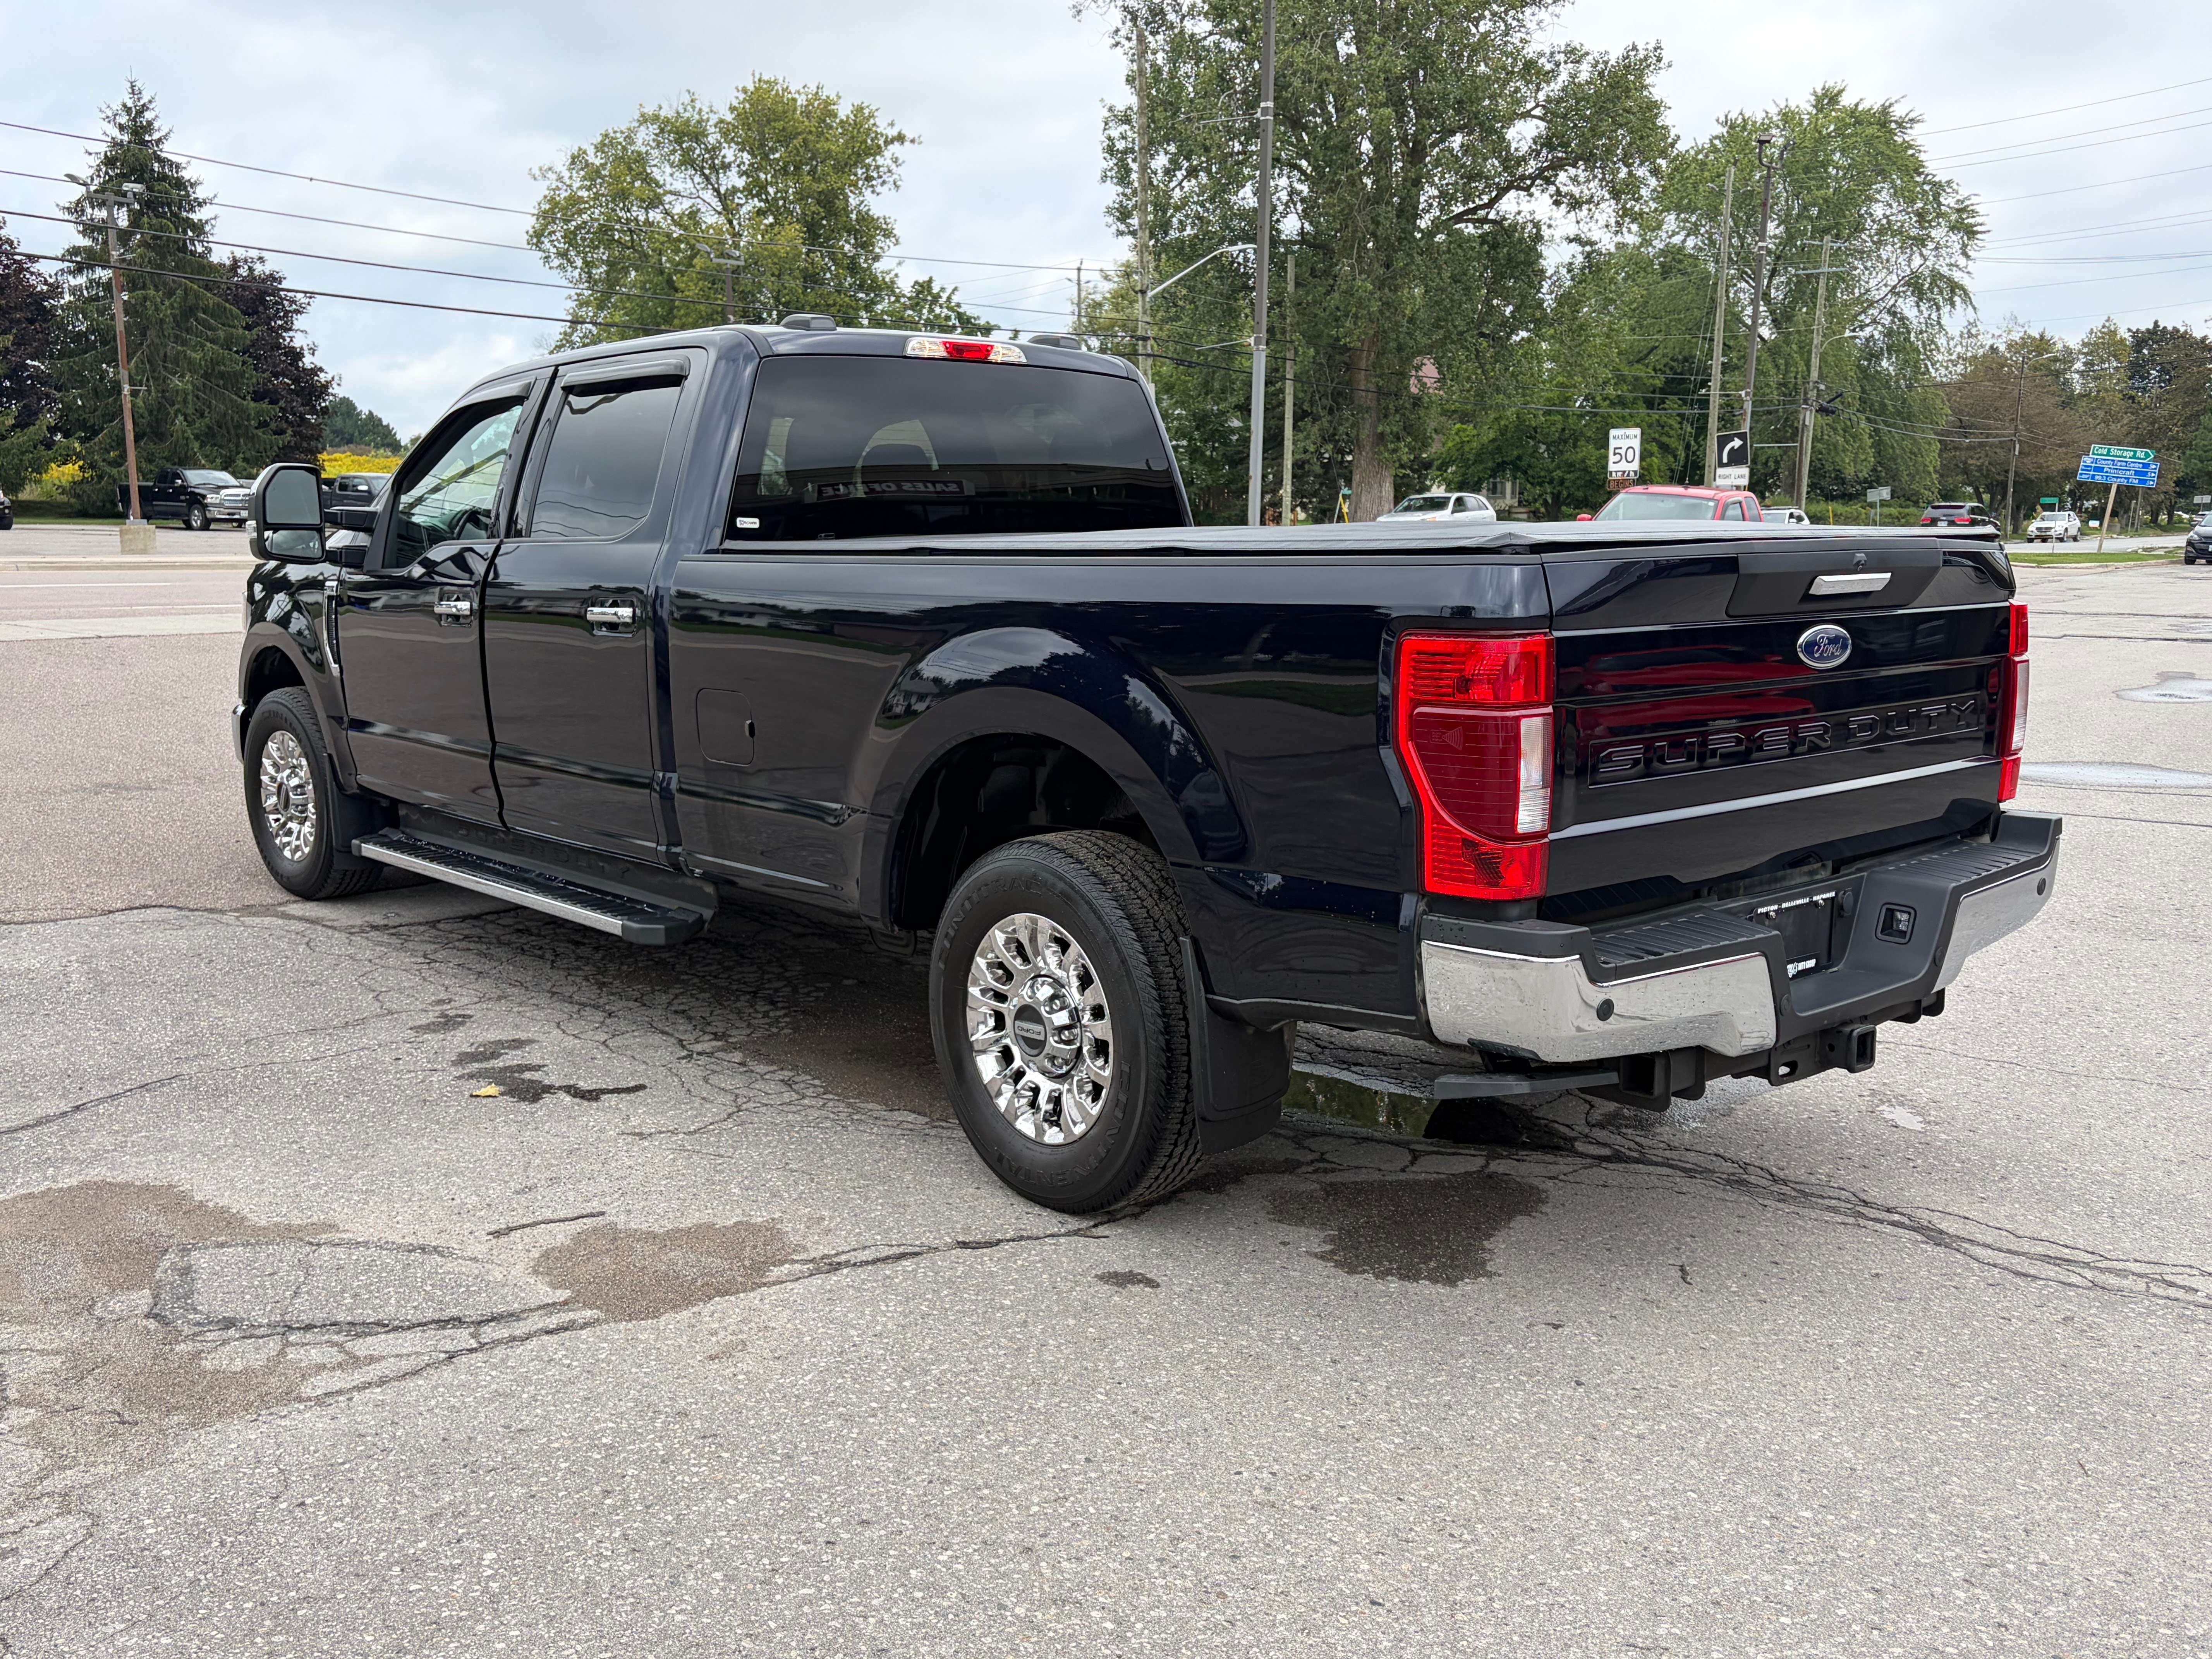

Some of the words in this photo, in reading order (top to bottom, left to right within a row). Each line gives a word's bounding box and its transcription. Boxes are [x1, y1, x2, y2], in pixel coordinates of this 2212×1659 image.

[1613, 446, 1635, 464] 50
[2110, 447, 2134, 459] Storage
[1610, 479, 1633, 489] BEGINS
[1814, 634, 1842, 657] Ford
[1597, 722, 1831, 778] SUPER
[1847, 700, 1975, 742] DUTY
[1758, 905, 1778, 914] PICTON
[1782, 898, 1809, 908] BELLEVILLE
[1017, 1026, 1041, 1036] FORD
